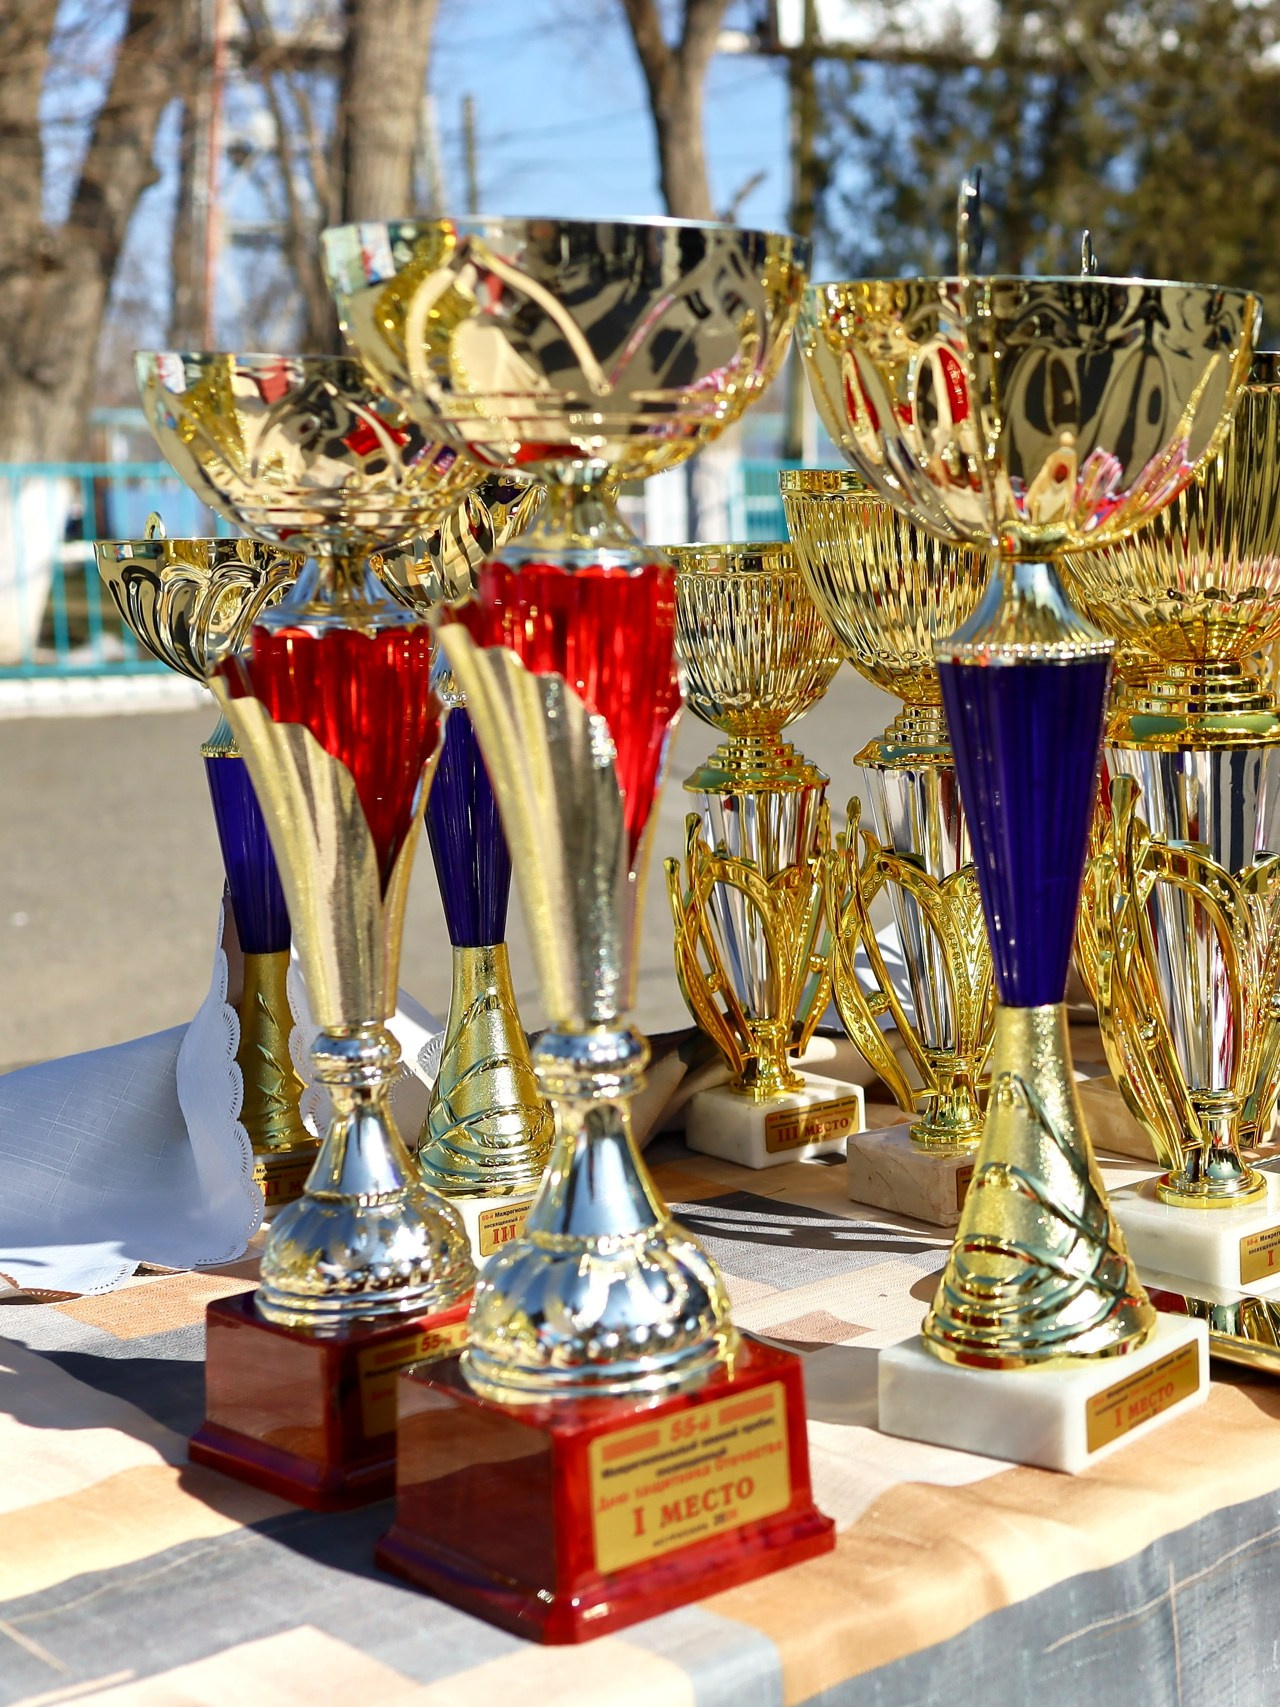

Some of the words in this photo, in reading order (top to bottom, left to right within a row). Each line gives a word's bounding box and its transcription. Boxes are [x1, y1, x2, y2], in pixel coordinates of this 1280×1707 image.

[804, 1117, 850, 1137] МЕСТО
[492, 1224, 517, 1245] III
[1127, 1381, 1175, 1421] МЕСТО
[659, 1475, 756, 1529] МЕСТО
